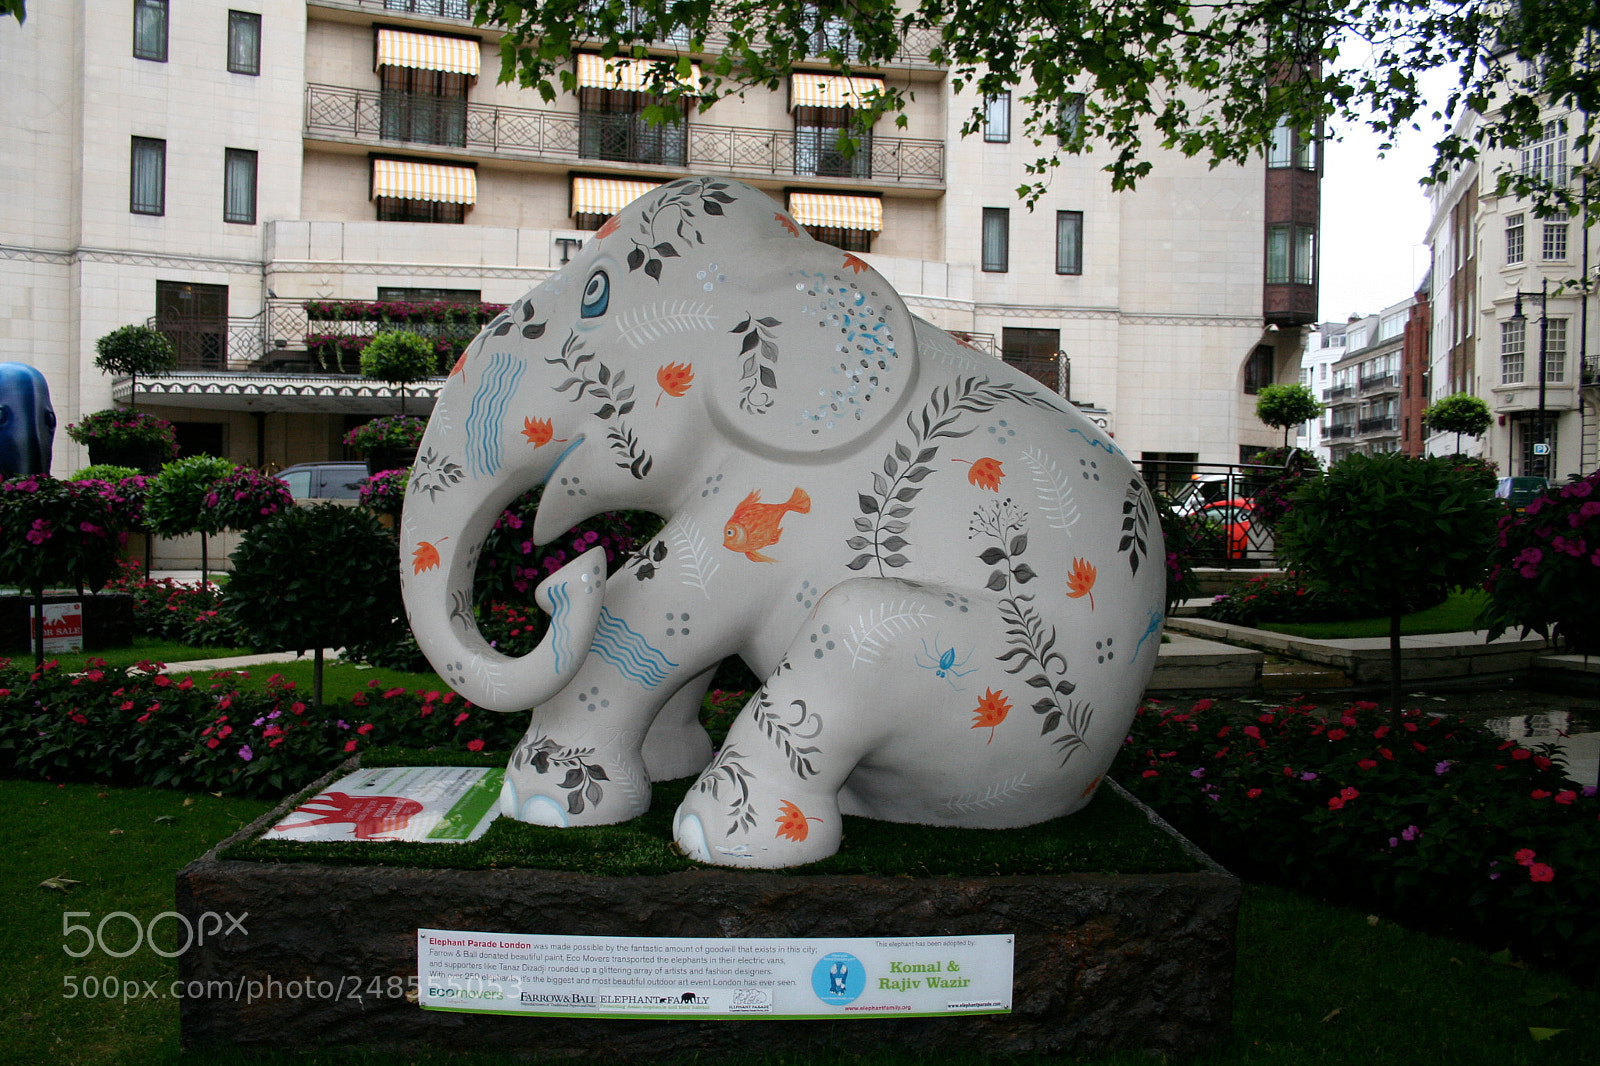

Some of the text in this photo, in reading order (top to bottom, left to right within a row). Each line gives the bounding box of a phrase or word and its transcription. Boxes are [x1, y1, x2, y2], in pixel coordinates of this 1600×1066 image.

[56, 627, 80, 635] SALE
[429, 937, 466, 948] Elephant
[467, 939, 498, 949] Parade
[500, 941, 531, 950] London
[550, 943, 571, 951] made
[573, 944, 603, 953] possible
[606, 944, 614, 953] by
[617, 944, 628, 952] the
[631, 944, 663, 952] fantastic
[665, 945, 693, 953] amount
[695, 945, 703, 953] of
[705, 945, 736, 954] goodwill
[738, 945, 753, 953] that
[754, 945, 777, 953] exists
[778, 945, 786, 953] in
[787, 945, 801, 953] this
[943, 940, 966, 948] adopted
[429, 948, 453, 957] Farrow
[455, 949, 461, 957] &
[463, 950, 478, 958] Ball
[479, 951, 509, 960] donated
[511, 952, 543, 961] beautiful
[566, 954, 580, 962] Eco
[582, 954, 610, 963] Movers
[612, 955, 655, 964] transported
[671, 956, 708, 965] elephants
[709, 956, 717, 964] in
[718, 956, 735, 964] their
[737, 956, 765, 964] electric
[444, 962, 482, 970] supporters
[484, 962, 497, 970] like
[499, 963, 520, 971] Tanaz
[548, 964, 579, 973] rounded
[580, 966, 590, 974] up
[599, 966, 632, 975] glittering
[634, 967, 652, 975] array
[664, 967, 687, 975] artists
[689, 967, 703, 975] and
[705, 967, 733, 975] fashion
[890, 960, 960, 973] Komal &
[429, 970, 446, 978] With
[464, 972, 480, 980] 250
[533, 975, 545, 983] the
[547, 976, 575, 985] biggest
[592, 977, 611, 985] most
[612, 978, 645, 986] beautiful
[647, 978, 676, 986] outdoor
[878, 976, 971, 992] Rajiv Wazir
[429, 988, 504, 1001] ECOmovers
[600, 995, 660, 1004] ELEPHANT
[947, 1001, 1002, 1009] www.elephantparade.com
